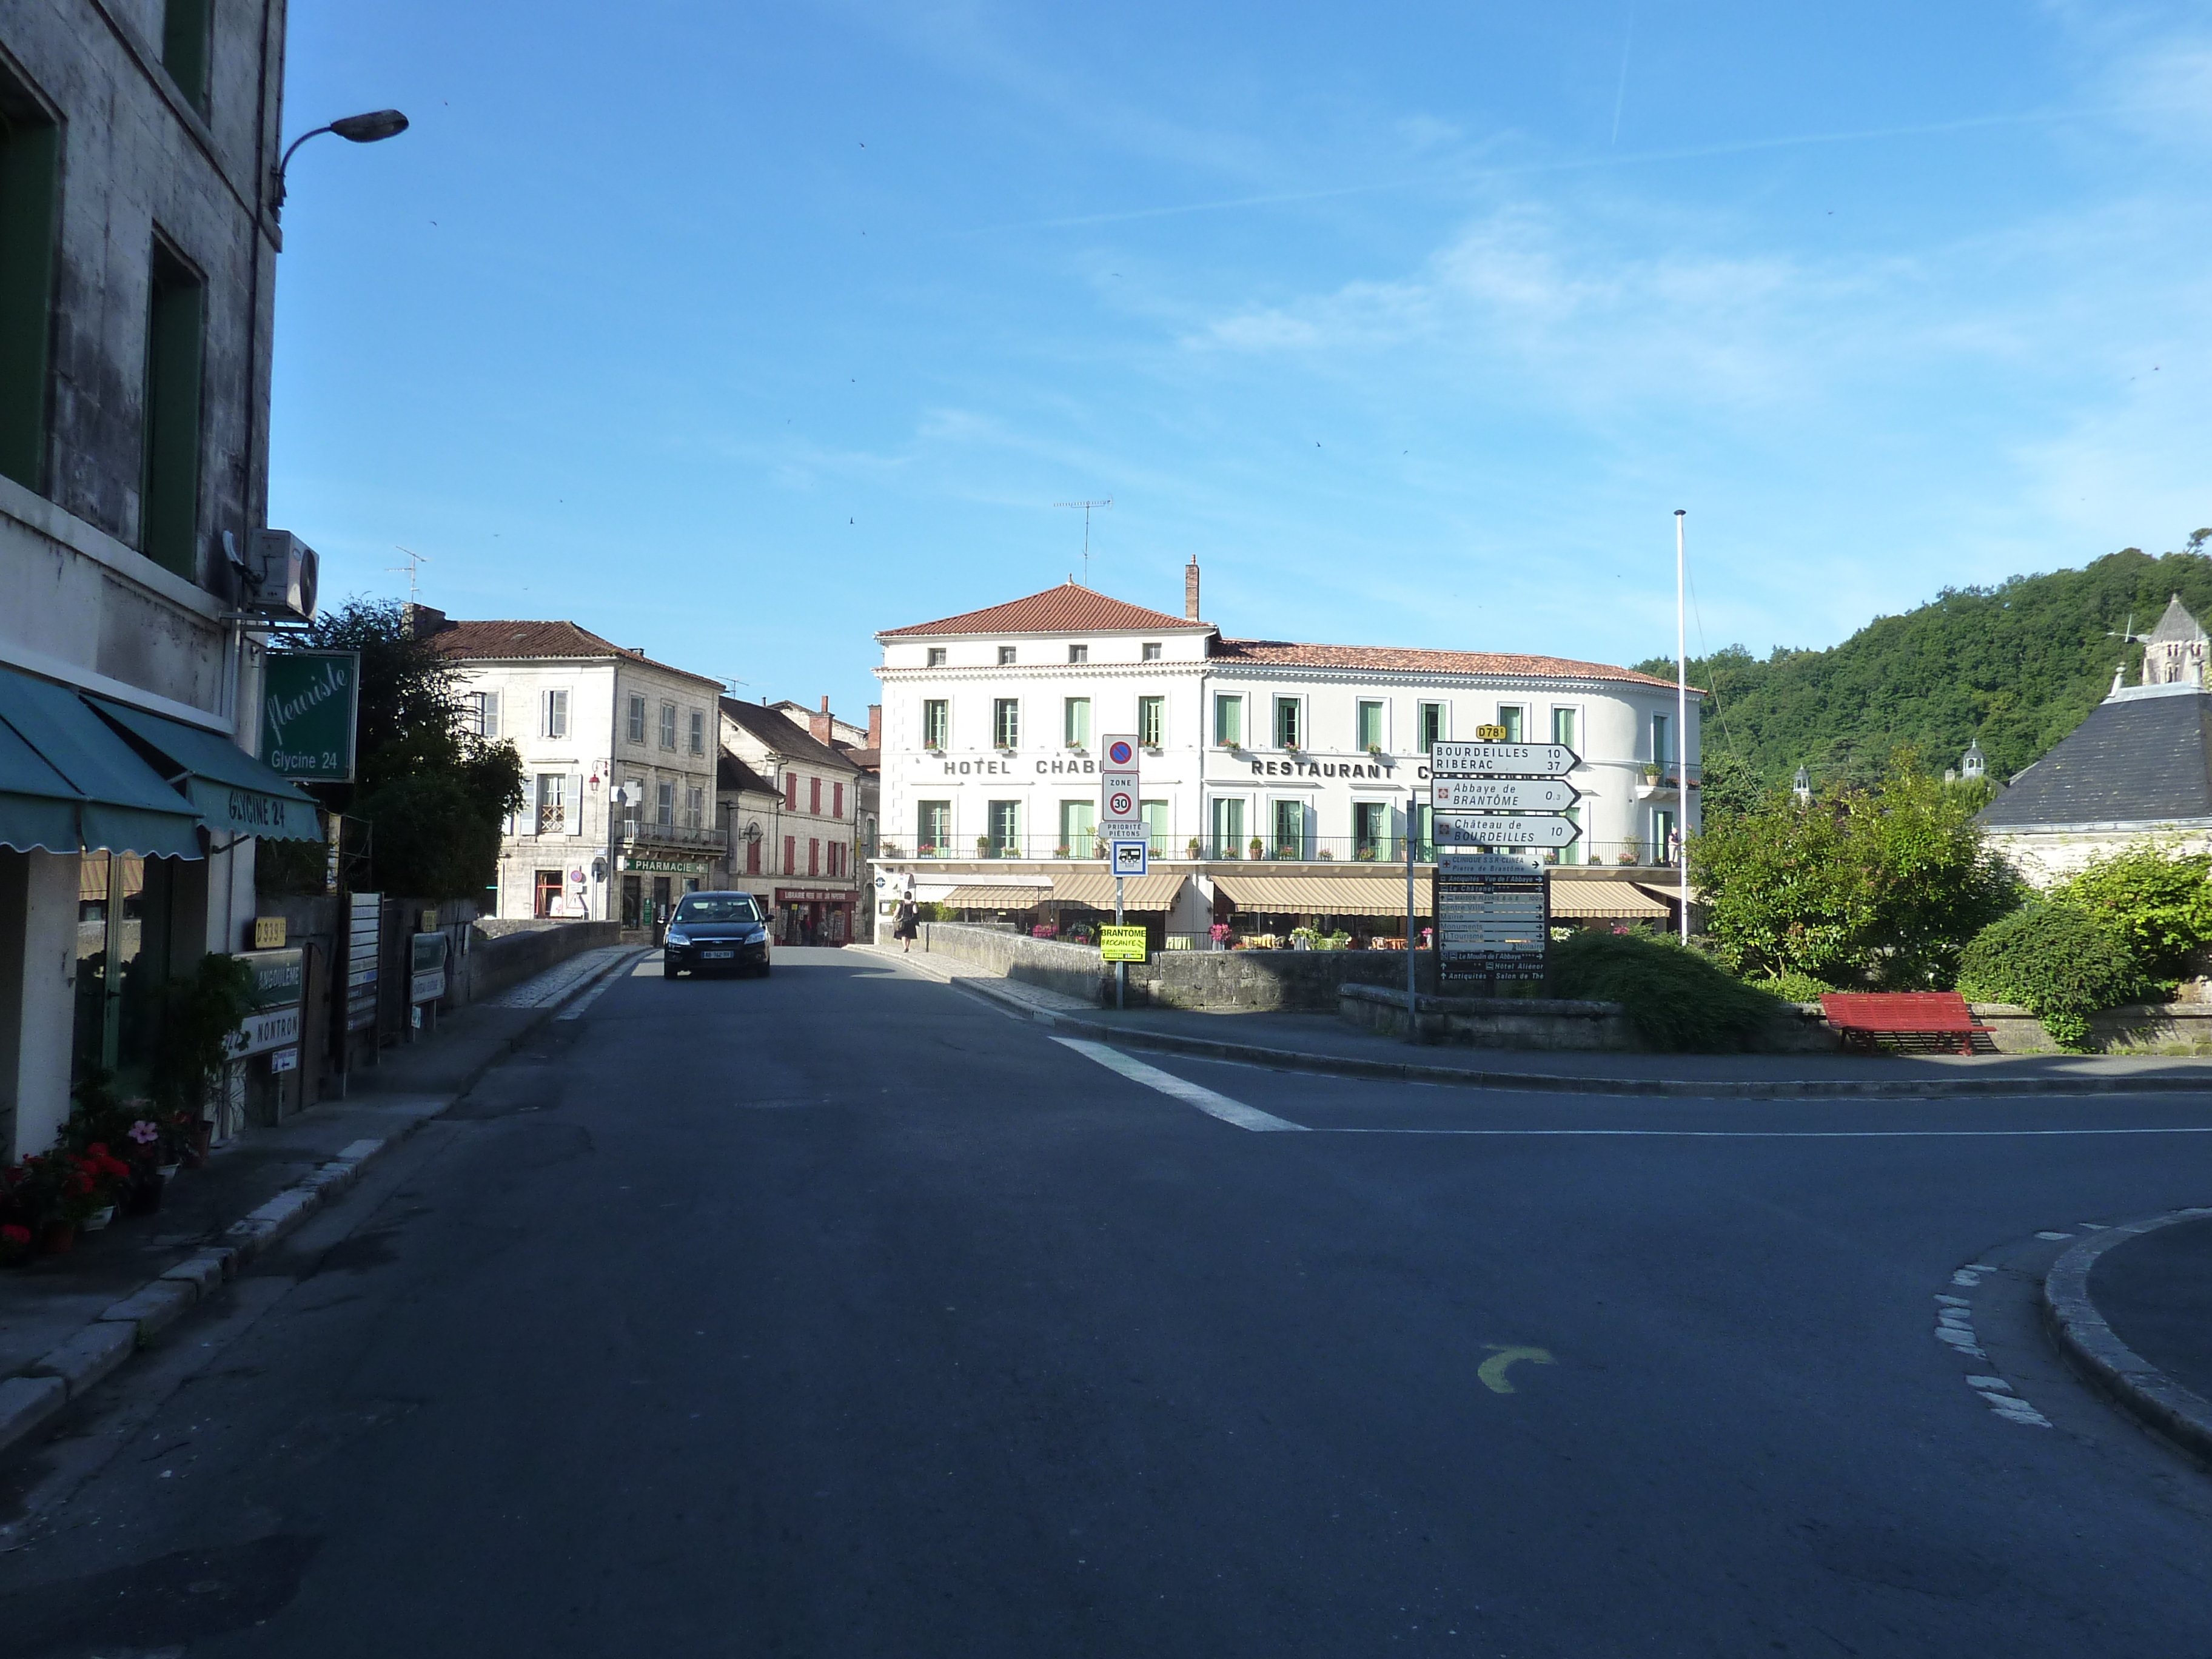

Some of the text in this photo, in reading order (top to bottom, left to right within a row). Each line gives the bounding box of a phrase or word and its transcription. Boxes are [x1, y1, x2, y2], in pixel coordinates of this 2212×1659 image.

[267, 662, 347, 746] fleuriste
[1436, 747, 1560, 758] BOURDEILLES 10
[272, 750, 338, 771] Glycine 24
[1436, 758, 1560, 771] RIBÉRAC 37
[944, 761, 1011, 775] HOTEL
[1252, 760, 1393, 779] RESTAURANT
[1453, 783, 1515, 794] Abbaye de
[1114, 799, 1127, 808] 30
[1453, 794, 1518, 806] BRANTÔME
[229, 789, 284, 828] GLYCINE 24
[1455, 819, 1563, 836] Château de 10
[1455, 832, 1534, 842] BOURDEILLES
[635, 860, 691, 871] PHARMACIE
[1101, 928, 1147, 937] BRANTÔME
[258, 1015, 297, 1043] NONTRON
